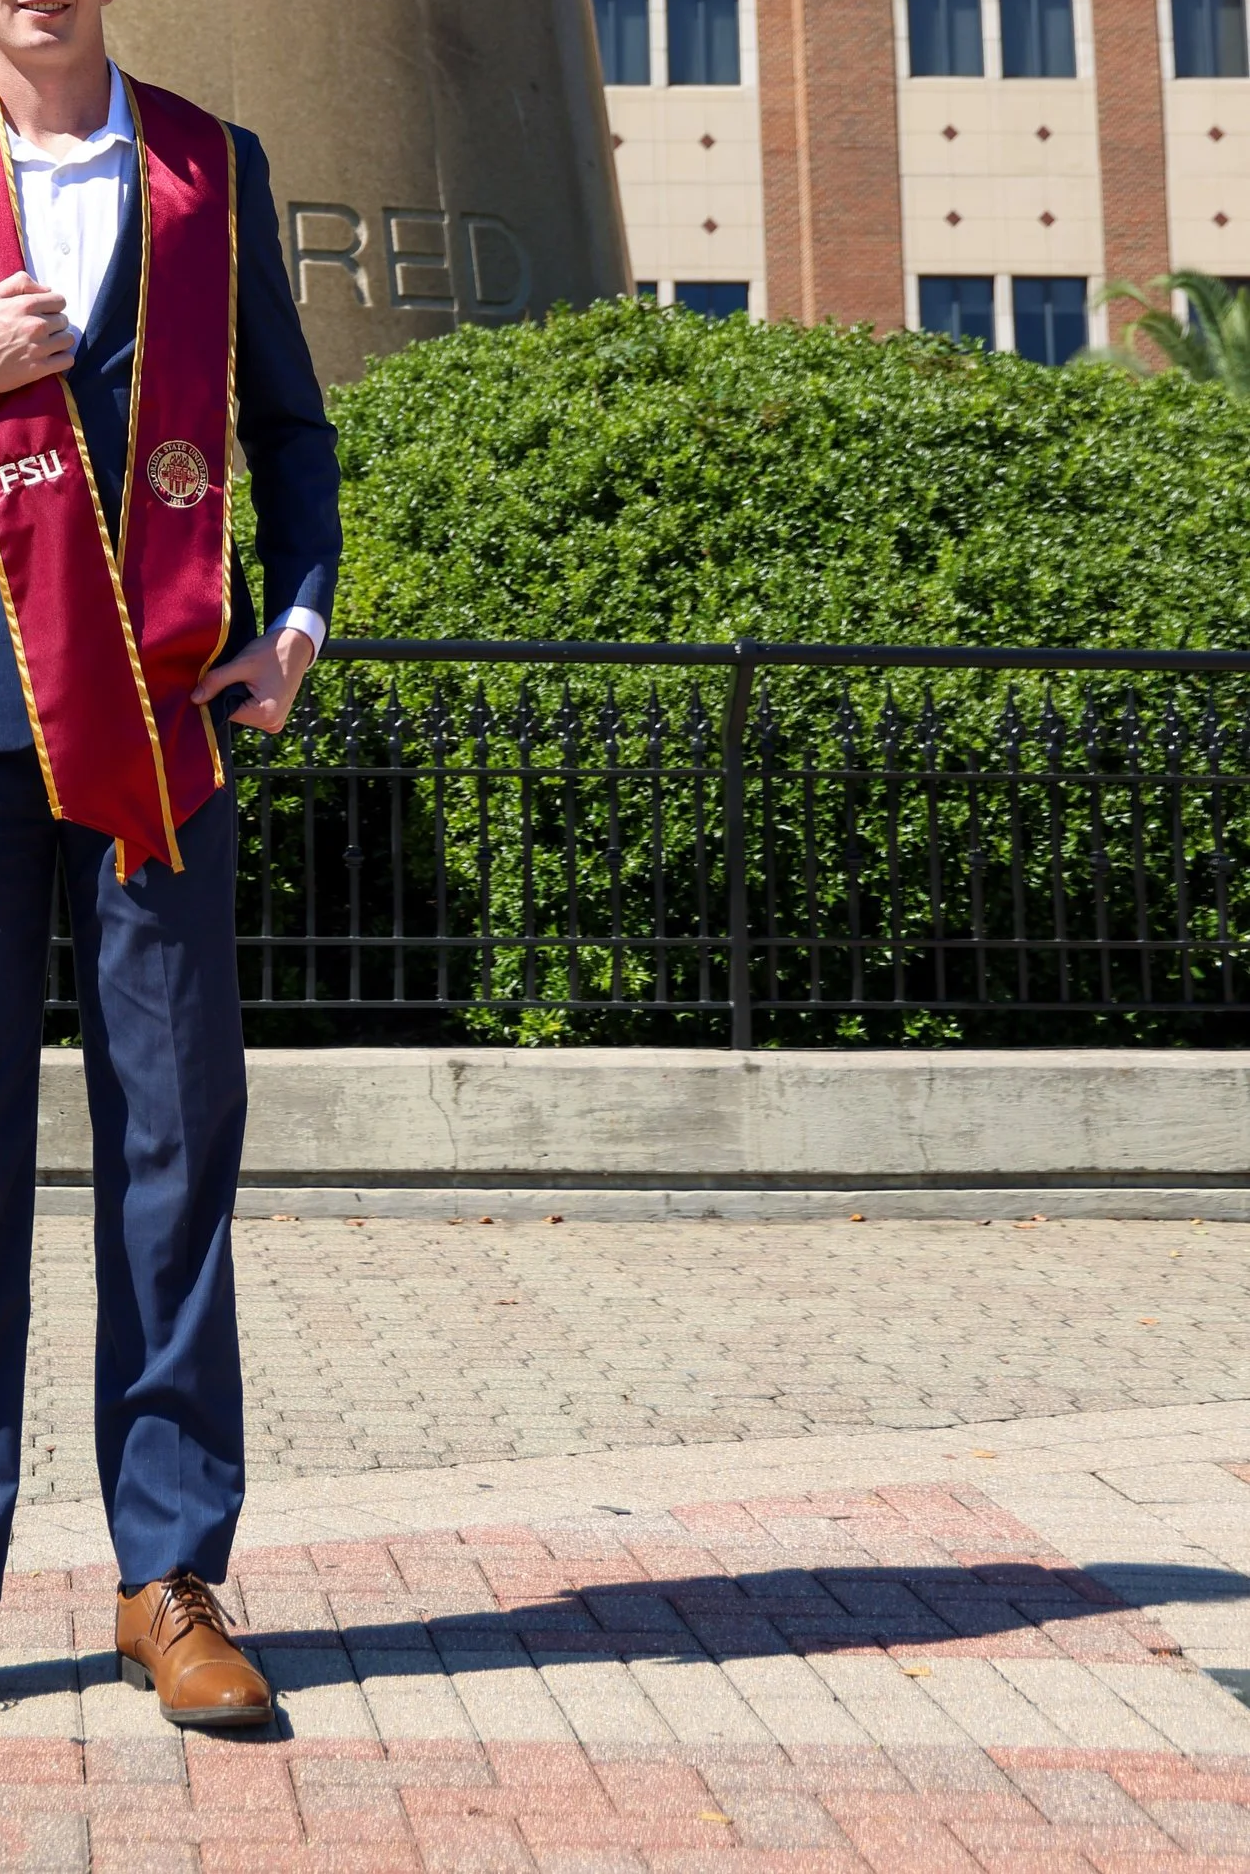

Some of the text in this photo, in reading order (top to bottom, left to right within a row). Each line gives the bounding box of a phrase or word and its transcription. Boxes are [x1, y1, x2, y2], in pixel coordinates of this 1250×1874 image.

[150, 443, 206, 496] FLORIDA STATE UNIVERSITY
